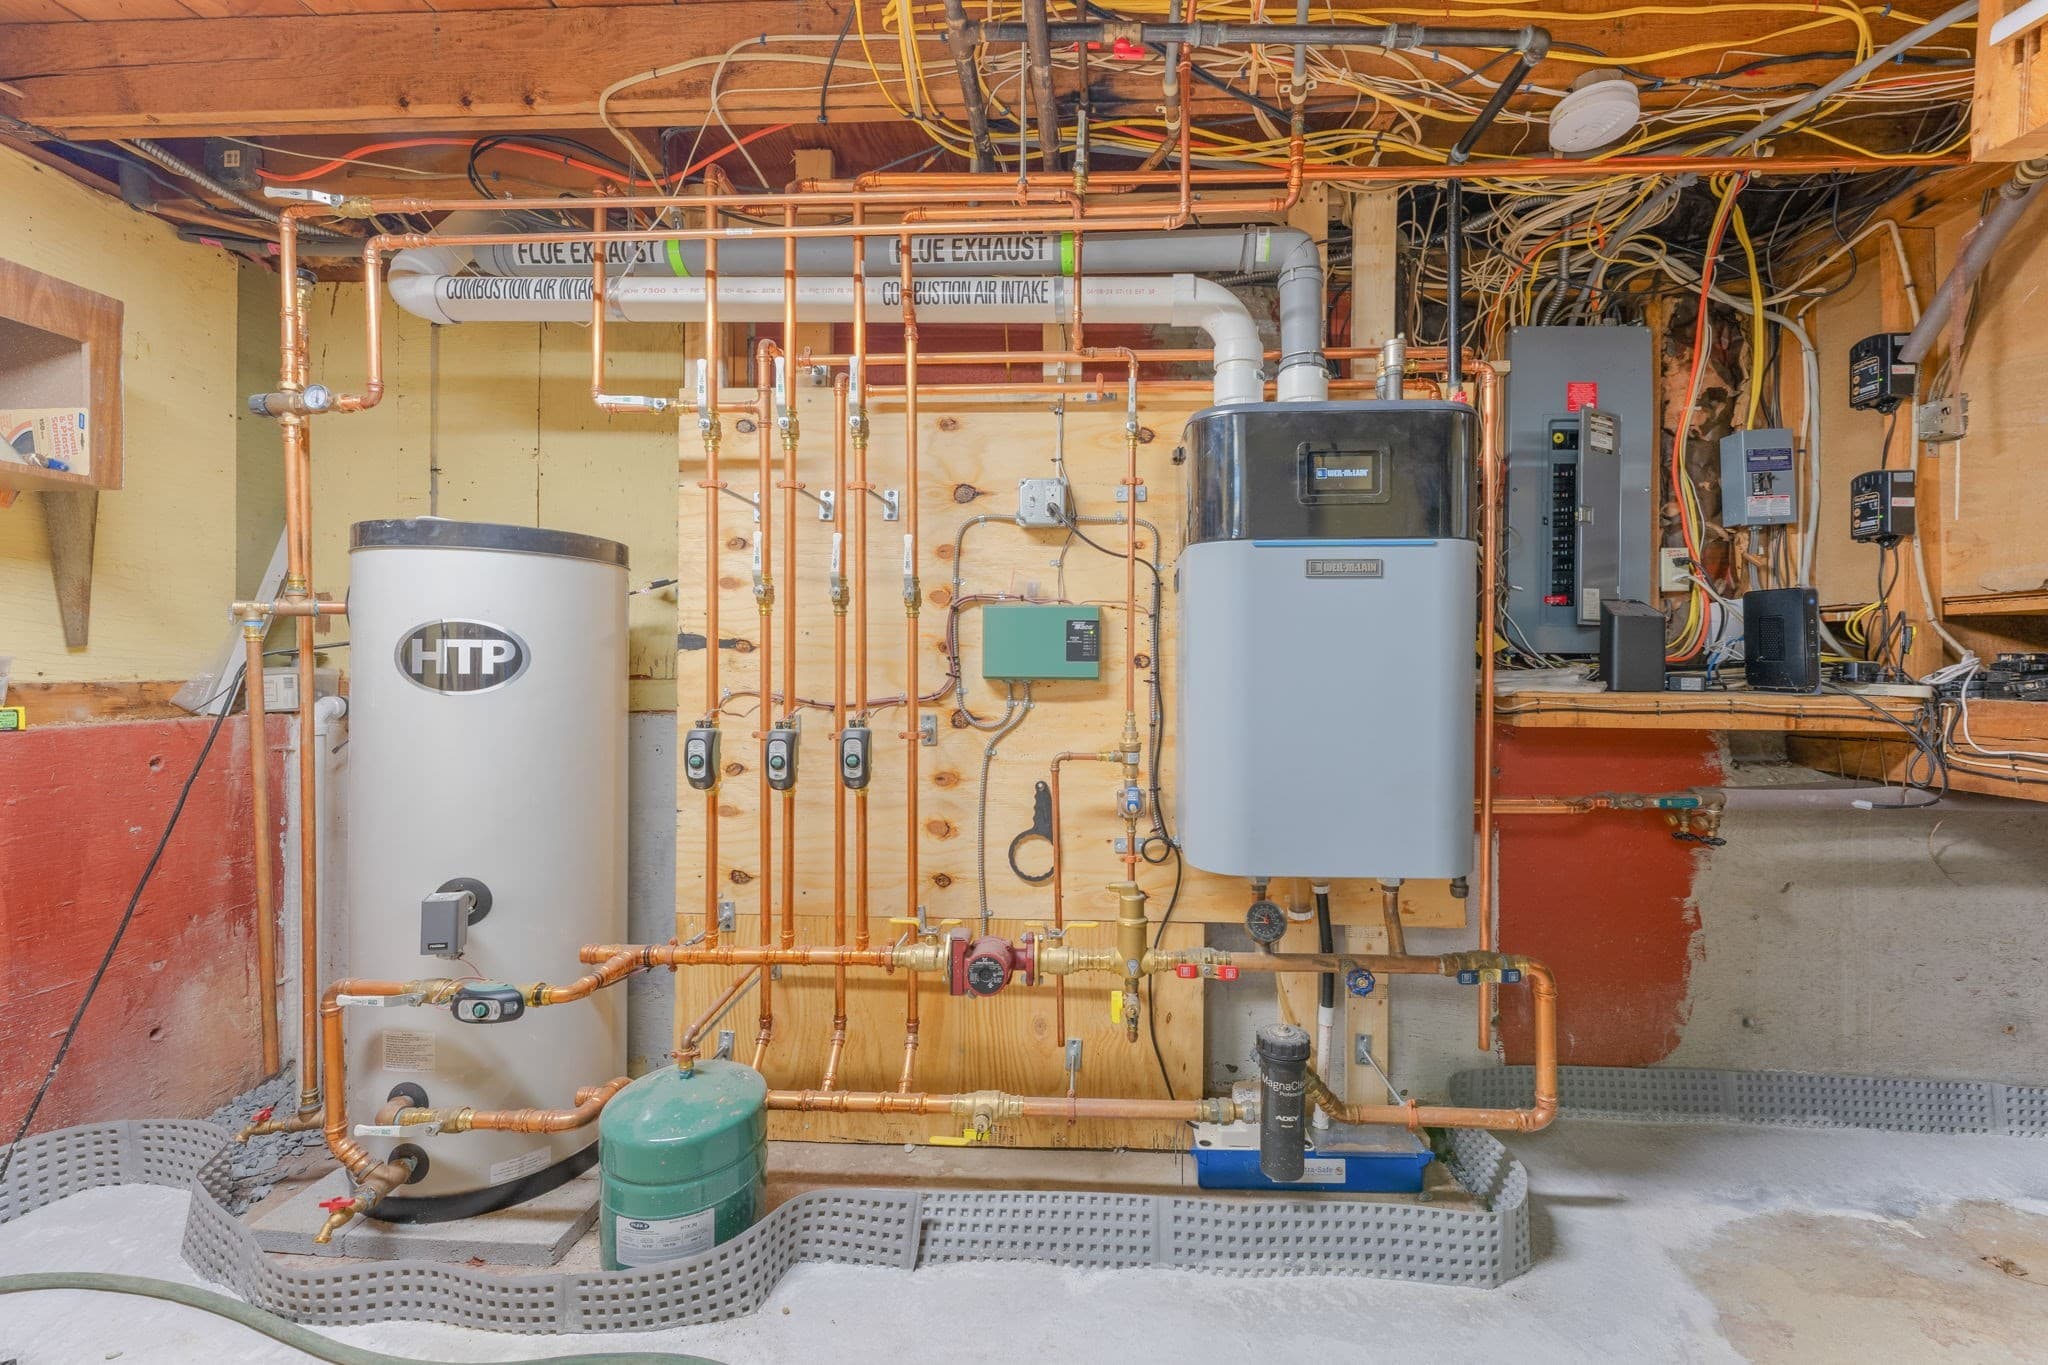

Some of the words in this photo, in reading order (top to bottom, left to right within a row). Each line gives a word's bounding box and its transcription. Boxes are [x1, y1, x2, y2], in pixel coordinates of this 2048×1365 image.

[517, 242, 565, 265] FLUE
[952, 236, 1048, 263] EXHAUST
[446, 278, 533, 300] COMBUSTION
[533, 278, 557, 300] AIR
[882, 280, 972, 306] COBUSTION
[975, 280, 997, 305] AIR
[1001, 279, 1049, 305] INTAKE
[411, 638, 517, 675] HTP
